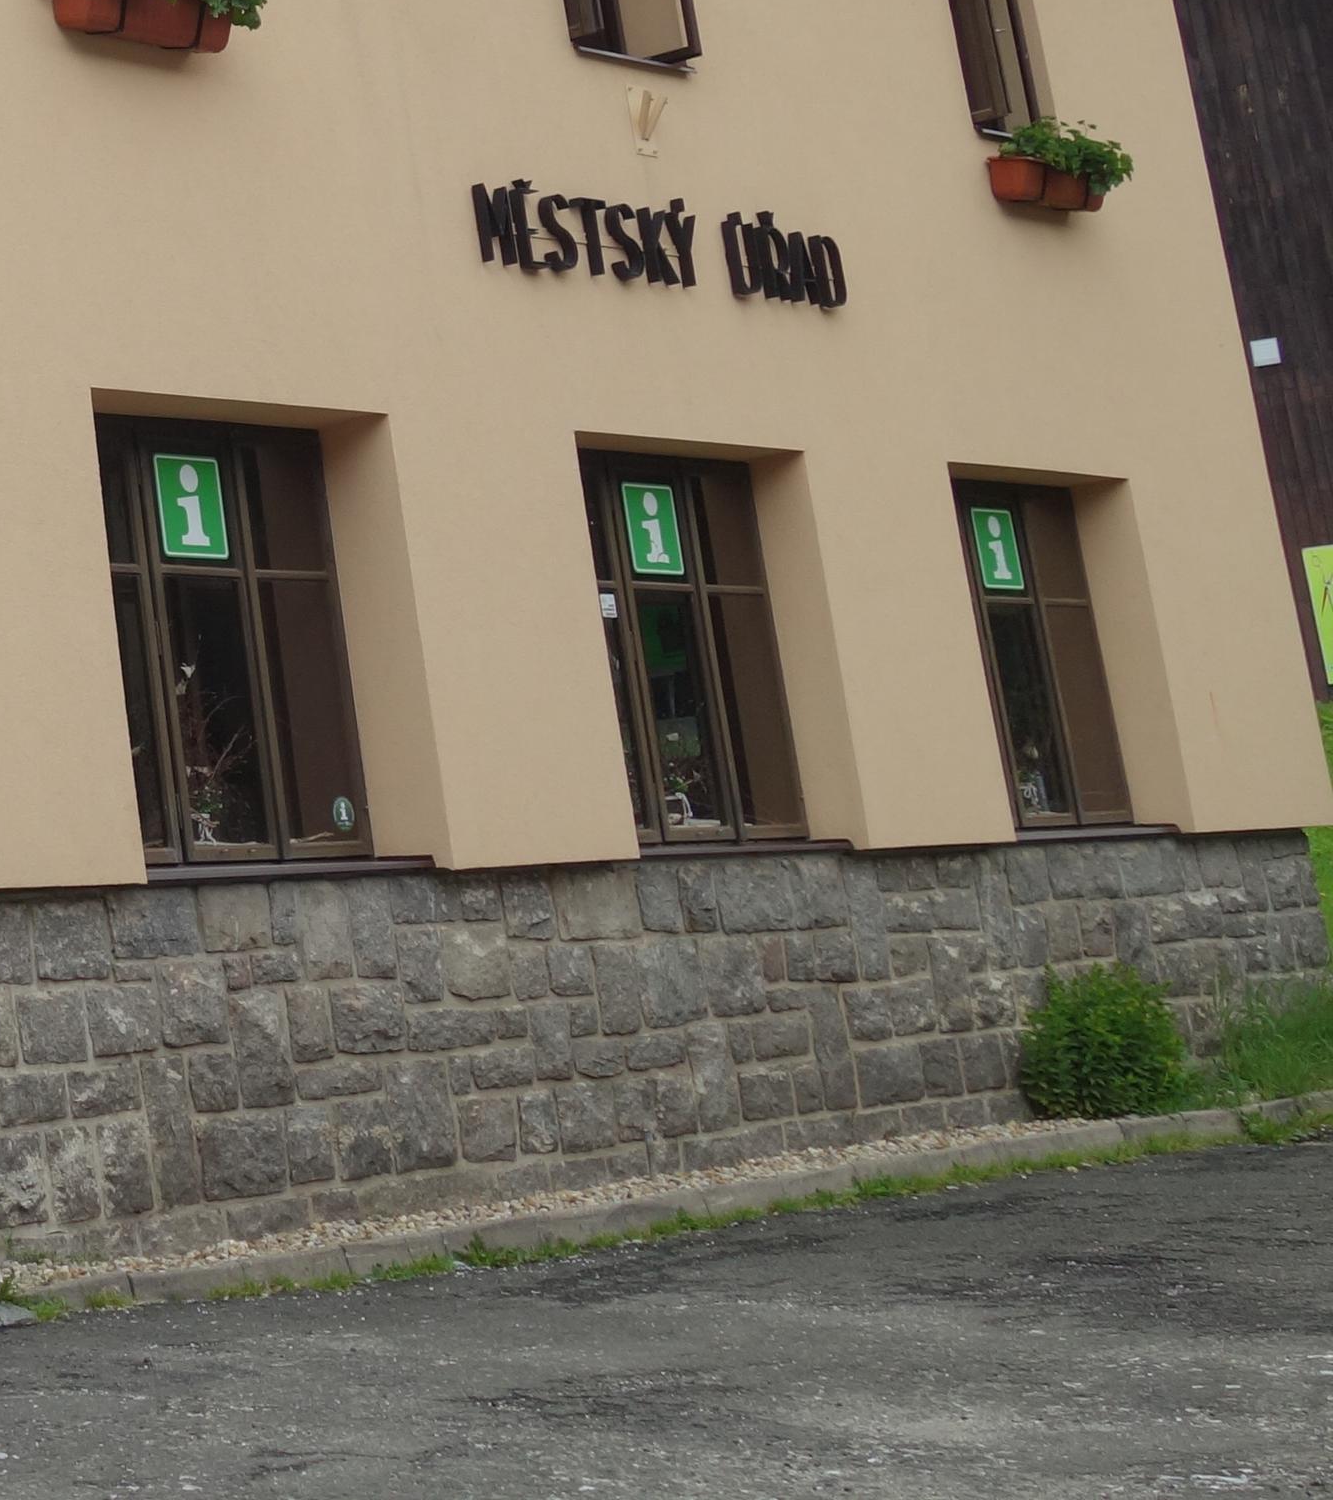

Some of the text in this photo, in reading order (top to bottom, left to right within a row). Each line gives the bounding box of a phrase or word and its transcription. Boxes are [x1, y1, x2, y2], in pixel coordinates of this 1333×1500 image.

[471, 178, 848, 309] MĚSTSKÝ ÚŘAD
[176, 464, 211, 547] i
[987, 515, 1013, 580] i
